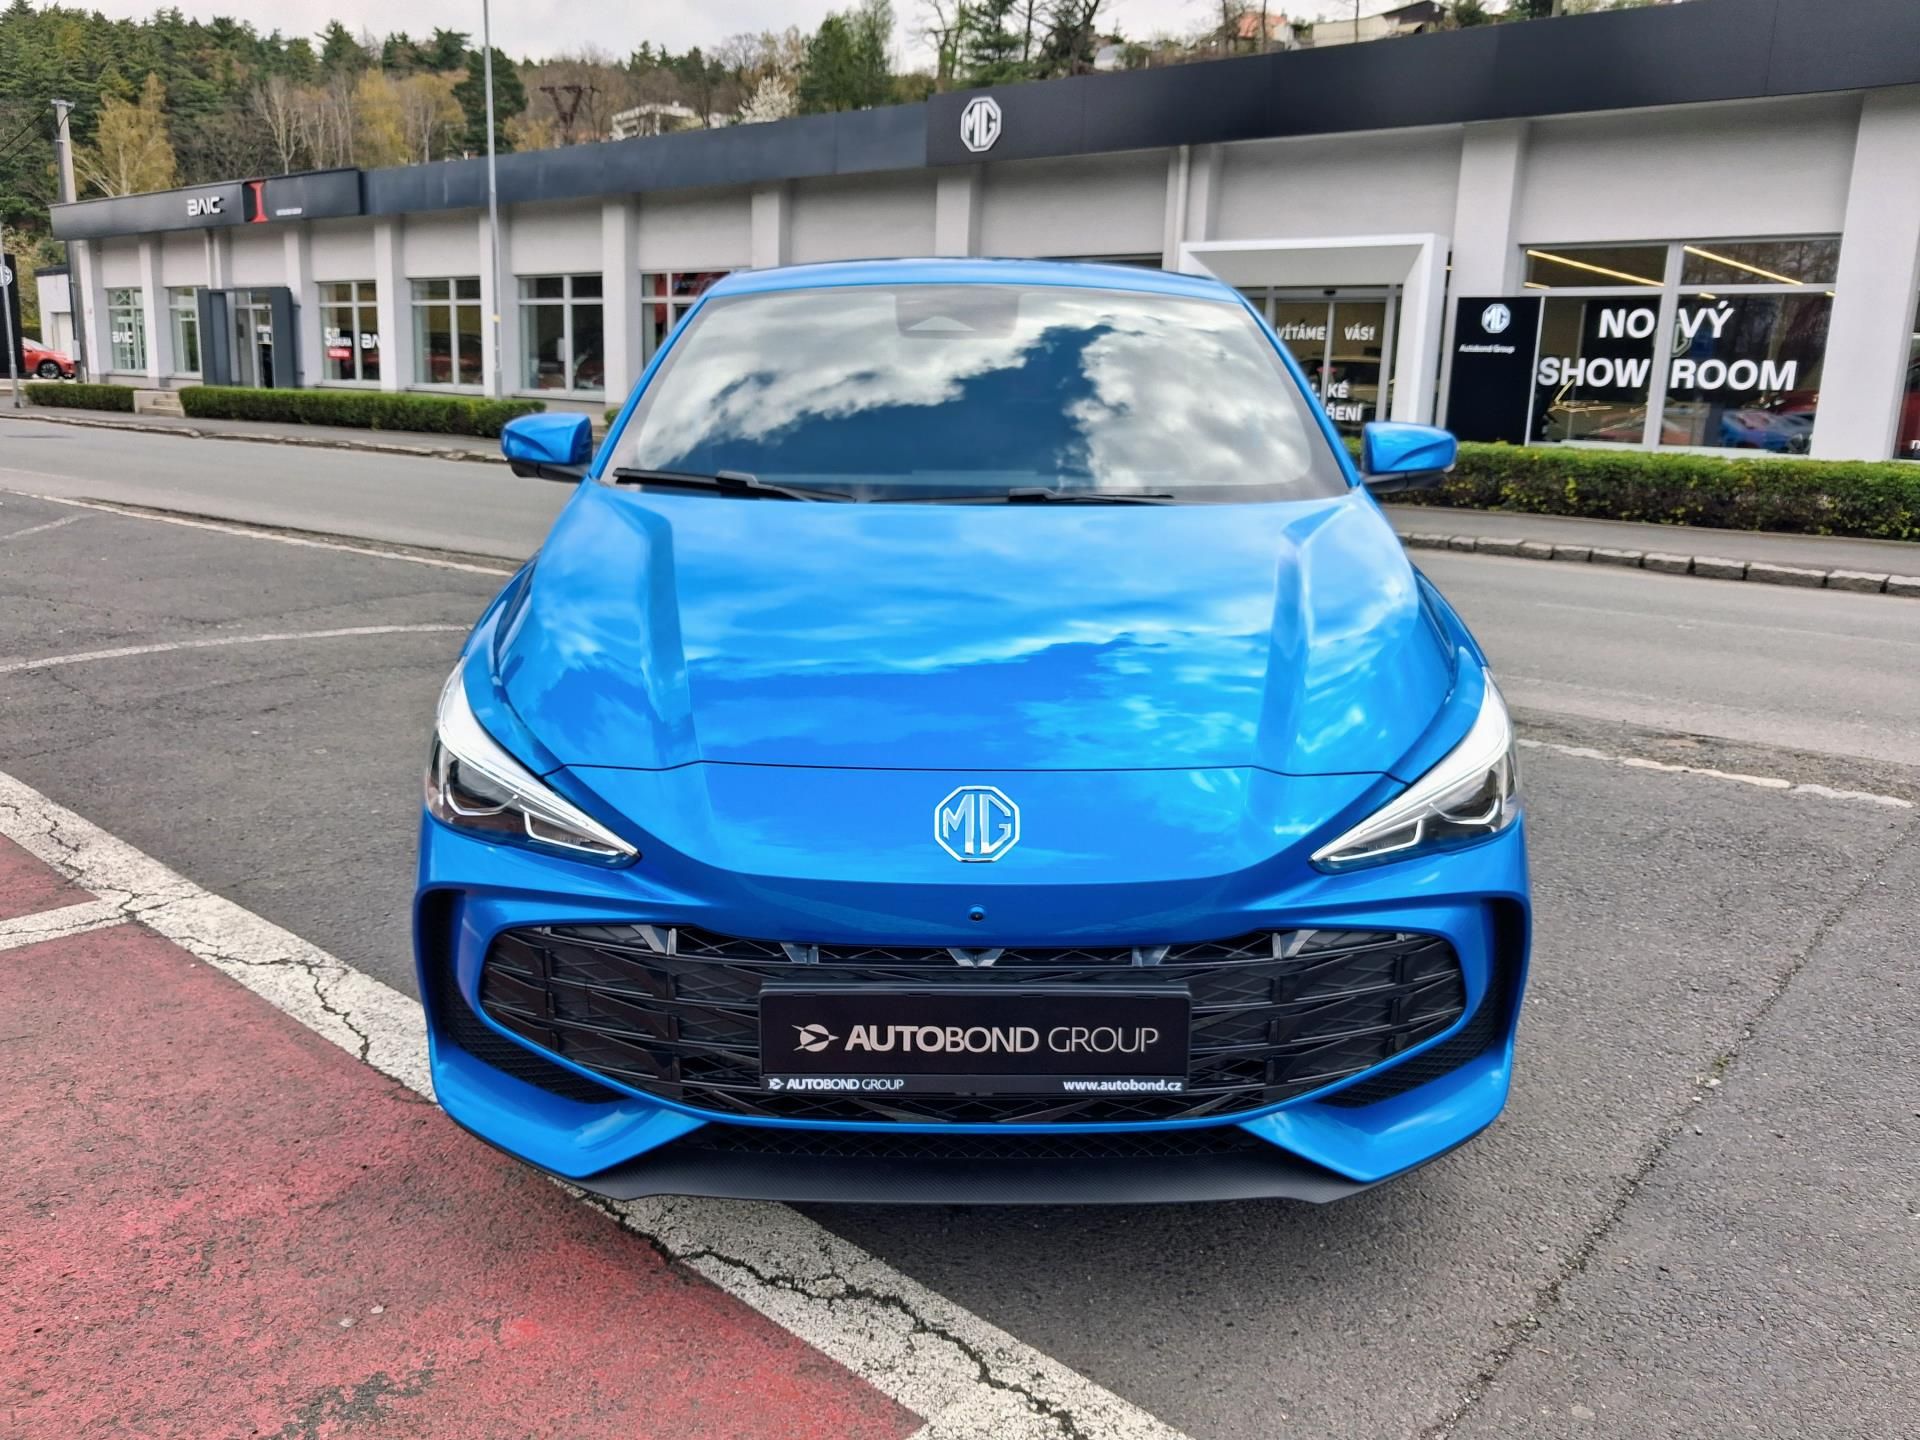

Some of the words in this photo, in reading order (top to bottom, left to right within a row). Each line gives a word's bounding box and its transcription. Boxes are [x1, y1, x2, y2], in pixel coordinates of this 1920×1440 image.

[962, 98, 1001, 150] MG
[187, 196, 222, 217] BAIC
[1483, 305, 1509, 332] MG
[1277, 322, 1326, 341] VÍTÁME
[1344, 322, 1375, 341] VÁS!
[937, 788, 1017, 860] MG
[844, 1023, 1040, 1053] AUTOBOND
[1046, 1026, 1159, 1054] GROUP
[786, 1078, 860, 1090] AUTOBOND
[861, 1078, 905, 1090] GROUP
[1062, 1078, 1184, 1092] www.autobond.cz
